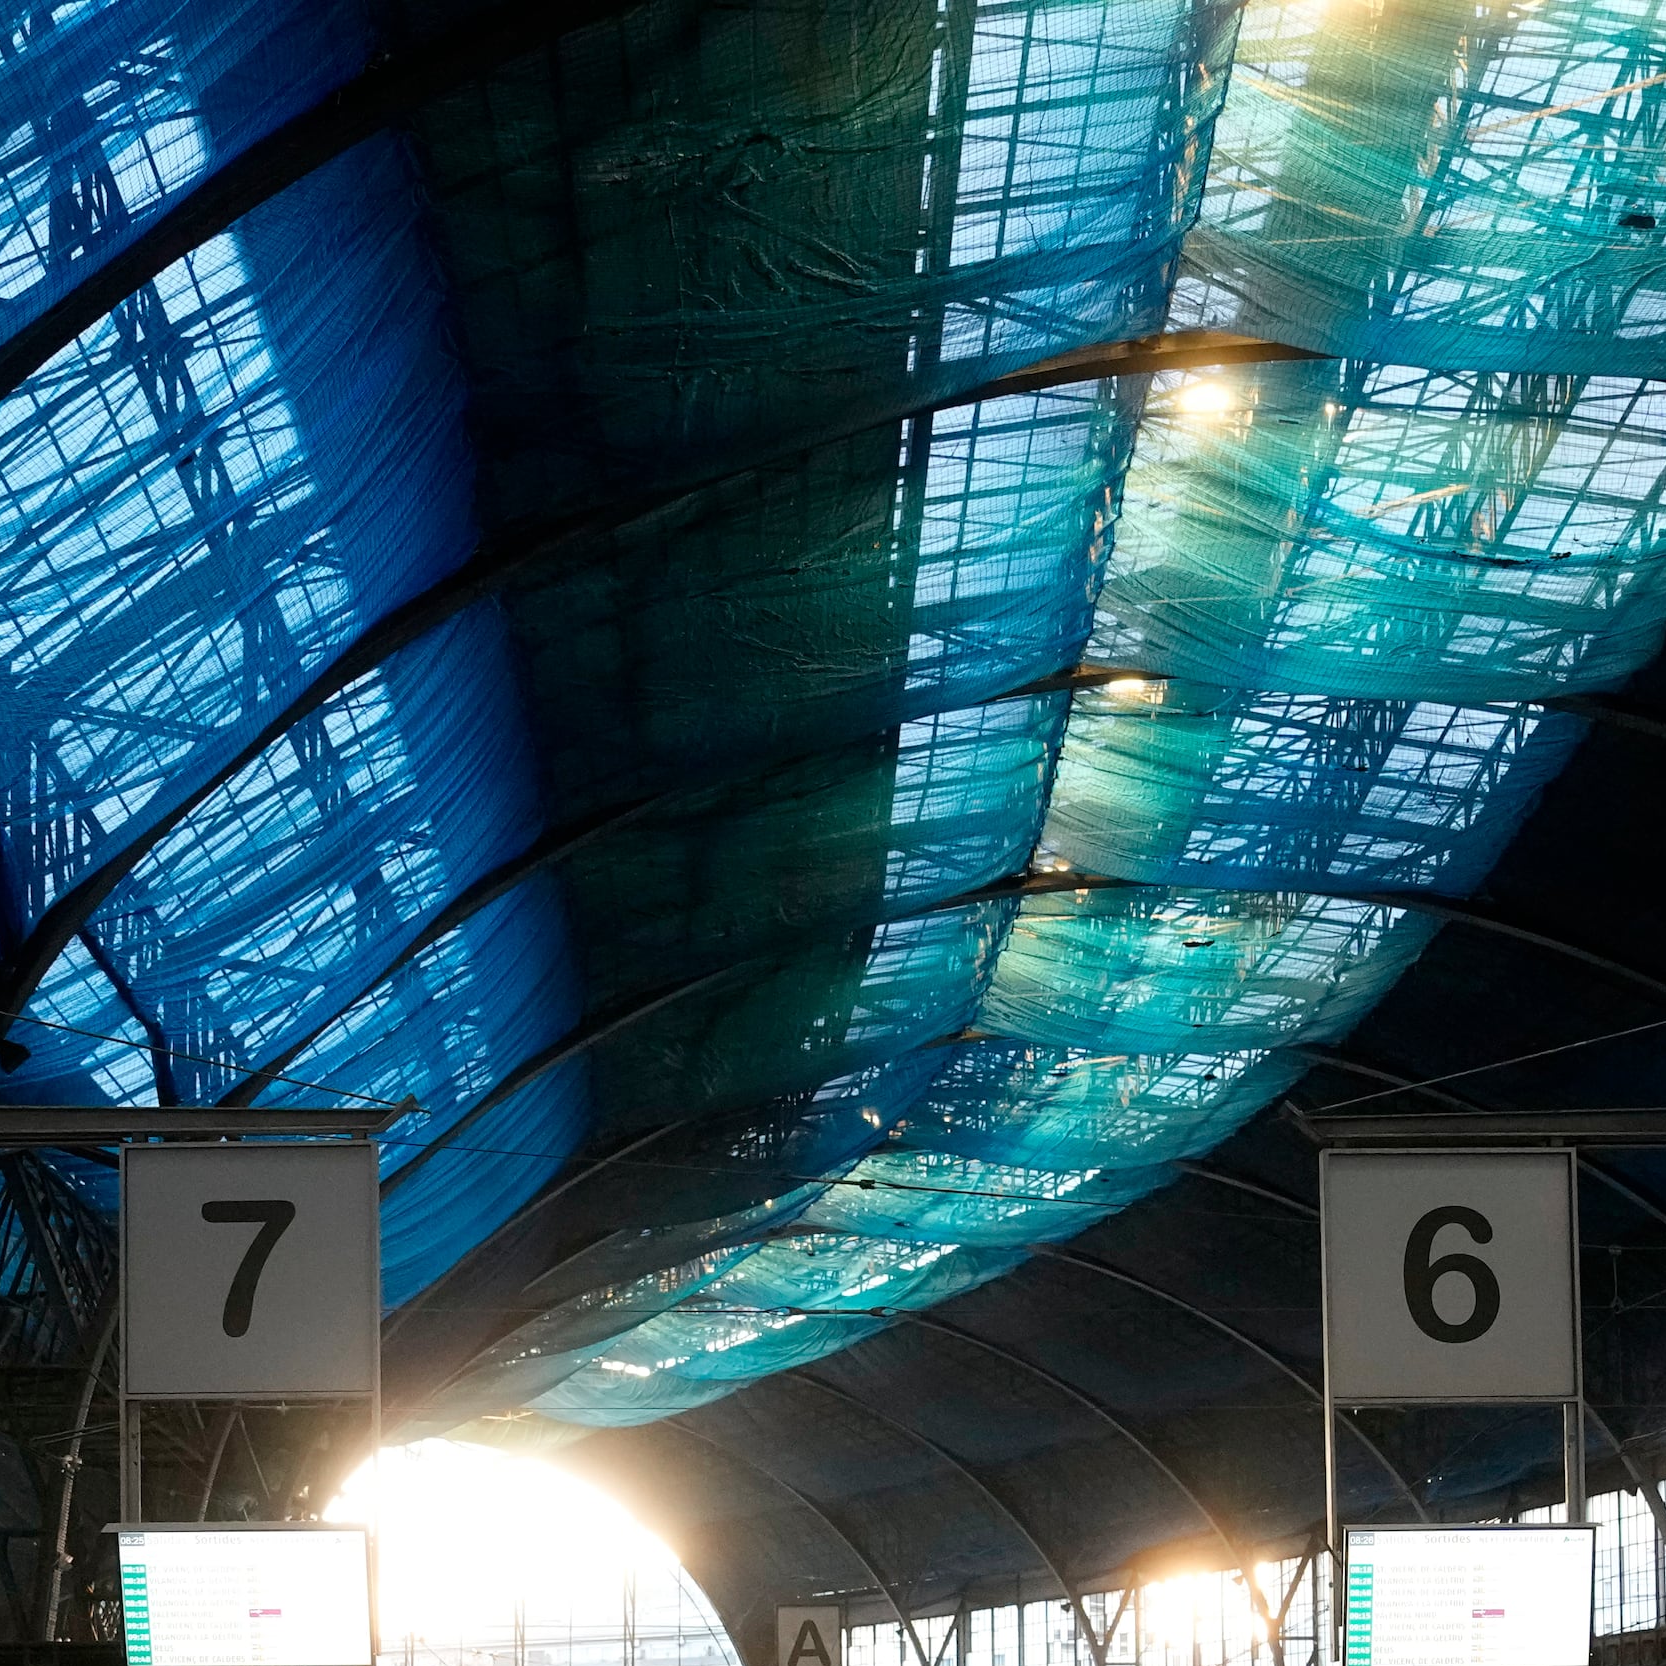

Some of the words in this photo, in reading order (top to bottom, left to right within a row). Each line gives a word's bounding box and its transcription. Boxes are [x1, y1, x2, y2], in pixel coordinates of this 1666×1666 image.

[201, 1200, 296, 1338] 7
[1403, 1205, 1501, 1344] 6
[195, 1535, 242, 1545] Sortides
[1424, 1534, 1471, 1544] Sortides
